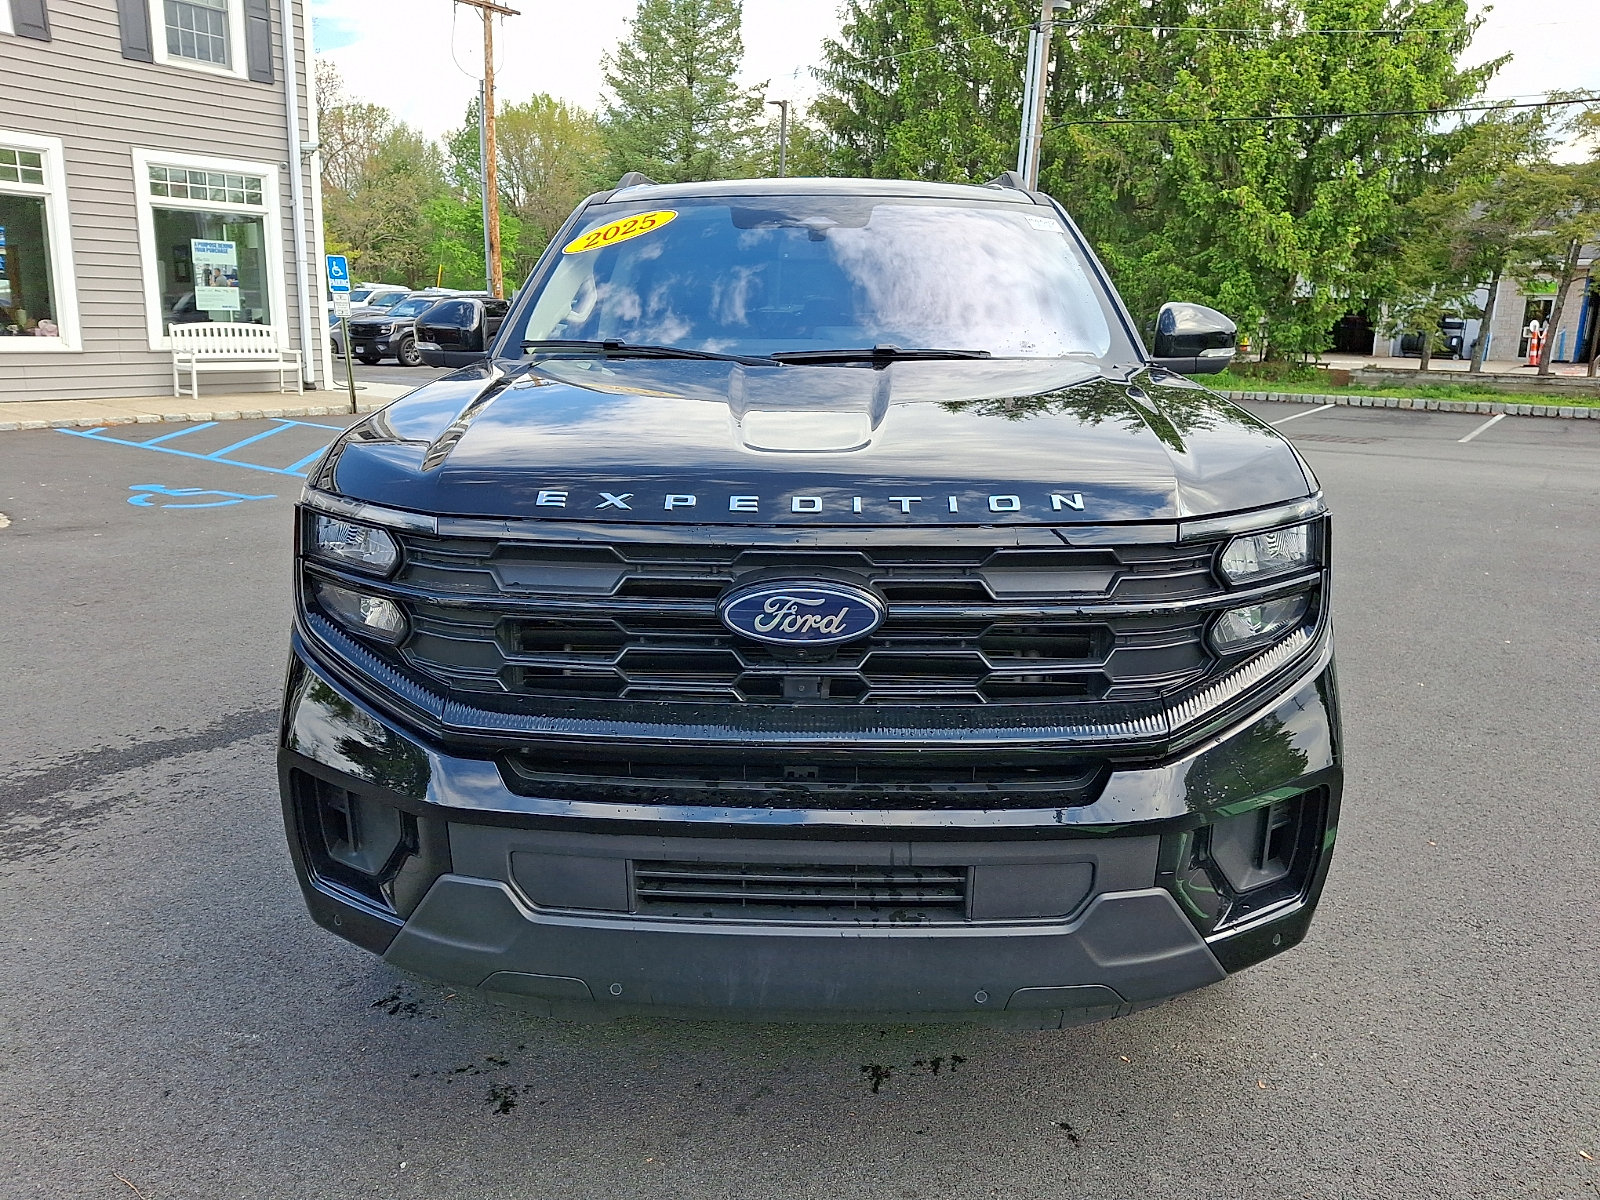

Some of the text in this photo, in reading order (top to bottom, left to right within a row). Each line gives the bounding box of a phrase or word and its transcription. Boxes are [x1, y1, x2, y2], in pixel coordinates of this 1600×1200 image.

[584, 213, 657, 248] 2025
[535, 489, 1085, 513] EXPEDITION
[754, 596, 849, 634] Ford
